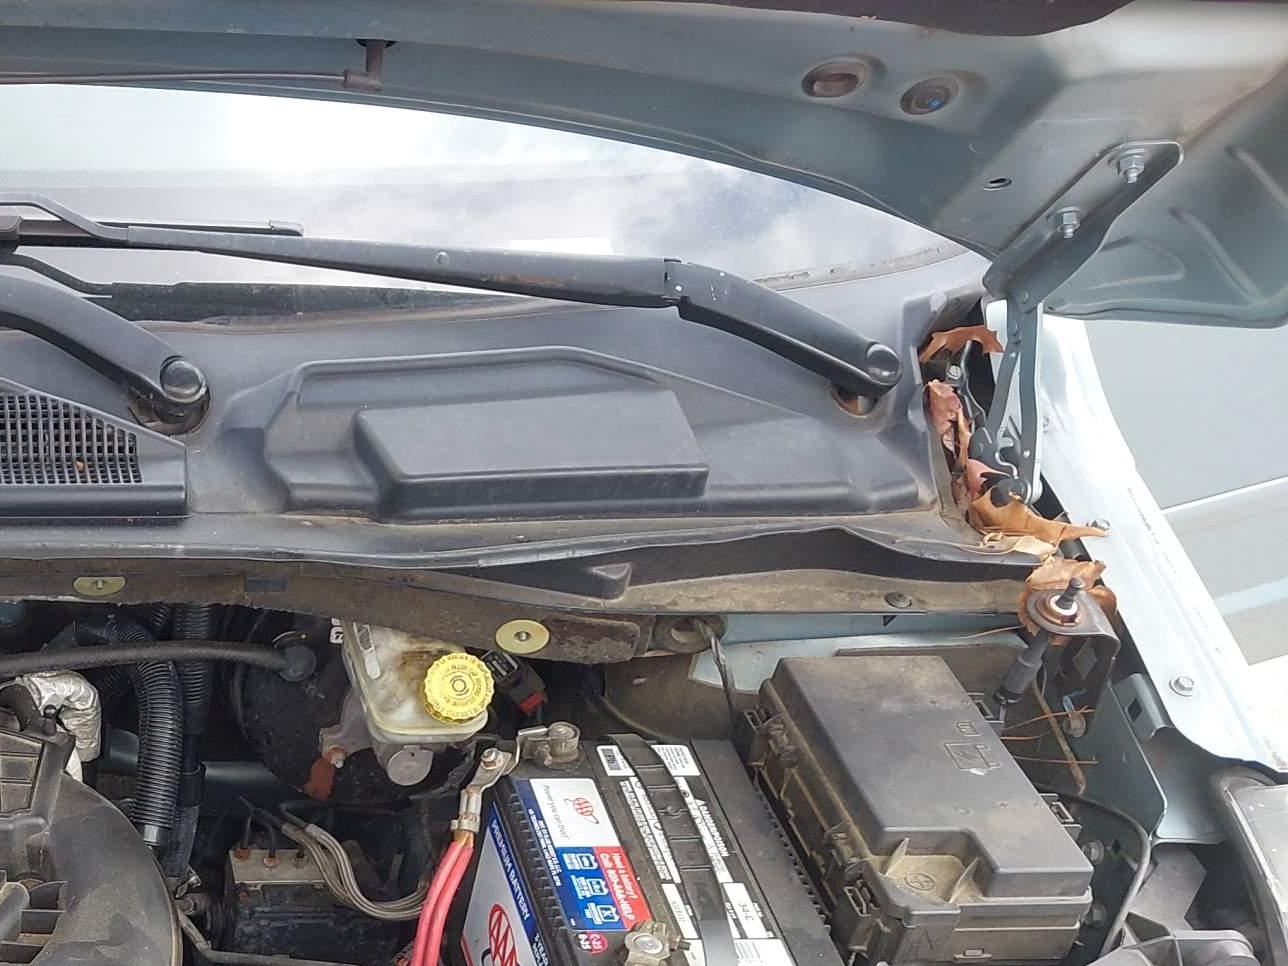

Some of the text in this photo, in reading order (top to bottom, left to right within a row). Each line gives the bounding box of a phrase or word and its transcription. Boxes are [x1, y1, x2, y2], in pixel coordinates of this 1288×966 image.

[541, 785, 555, 802] Power
[491, 819, 530, 921] PREMIUM BATTERY
[610, 852, 622, 868] Need
[619, 873, 638, 899] battery?
[607, 869, 635, 921] 800-AAA-HELP
